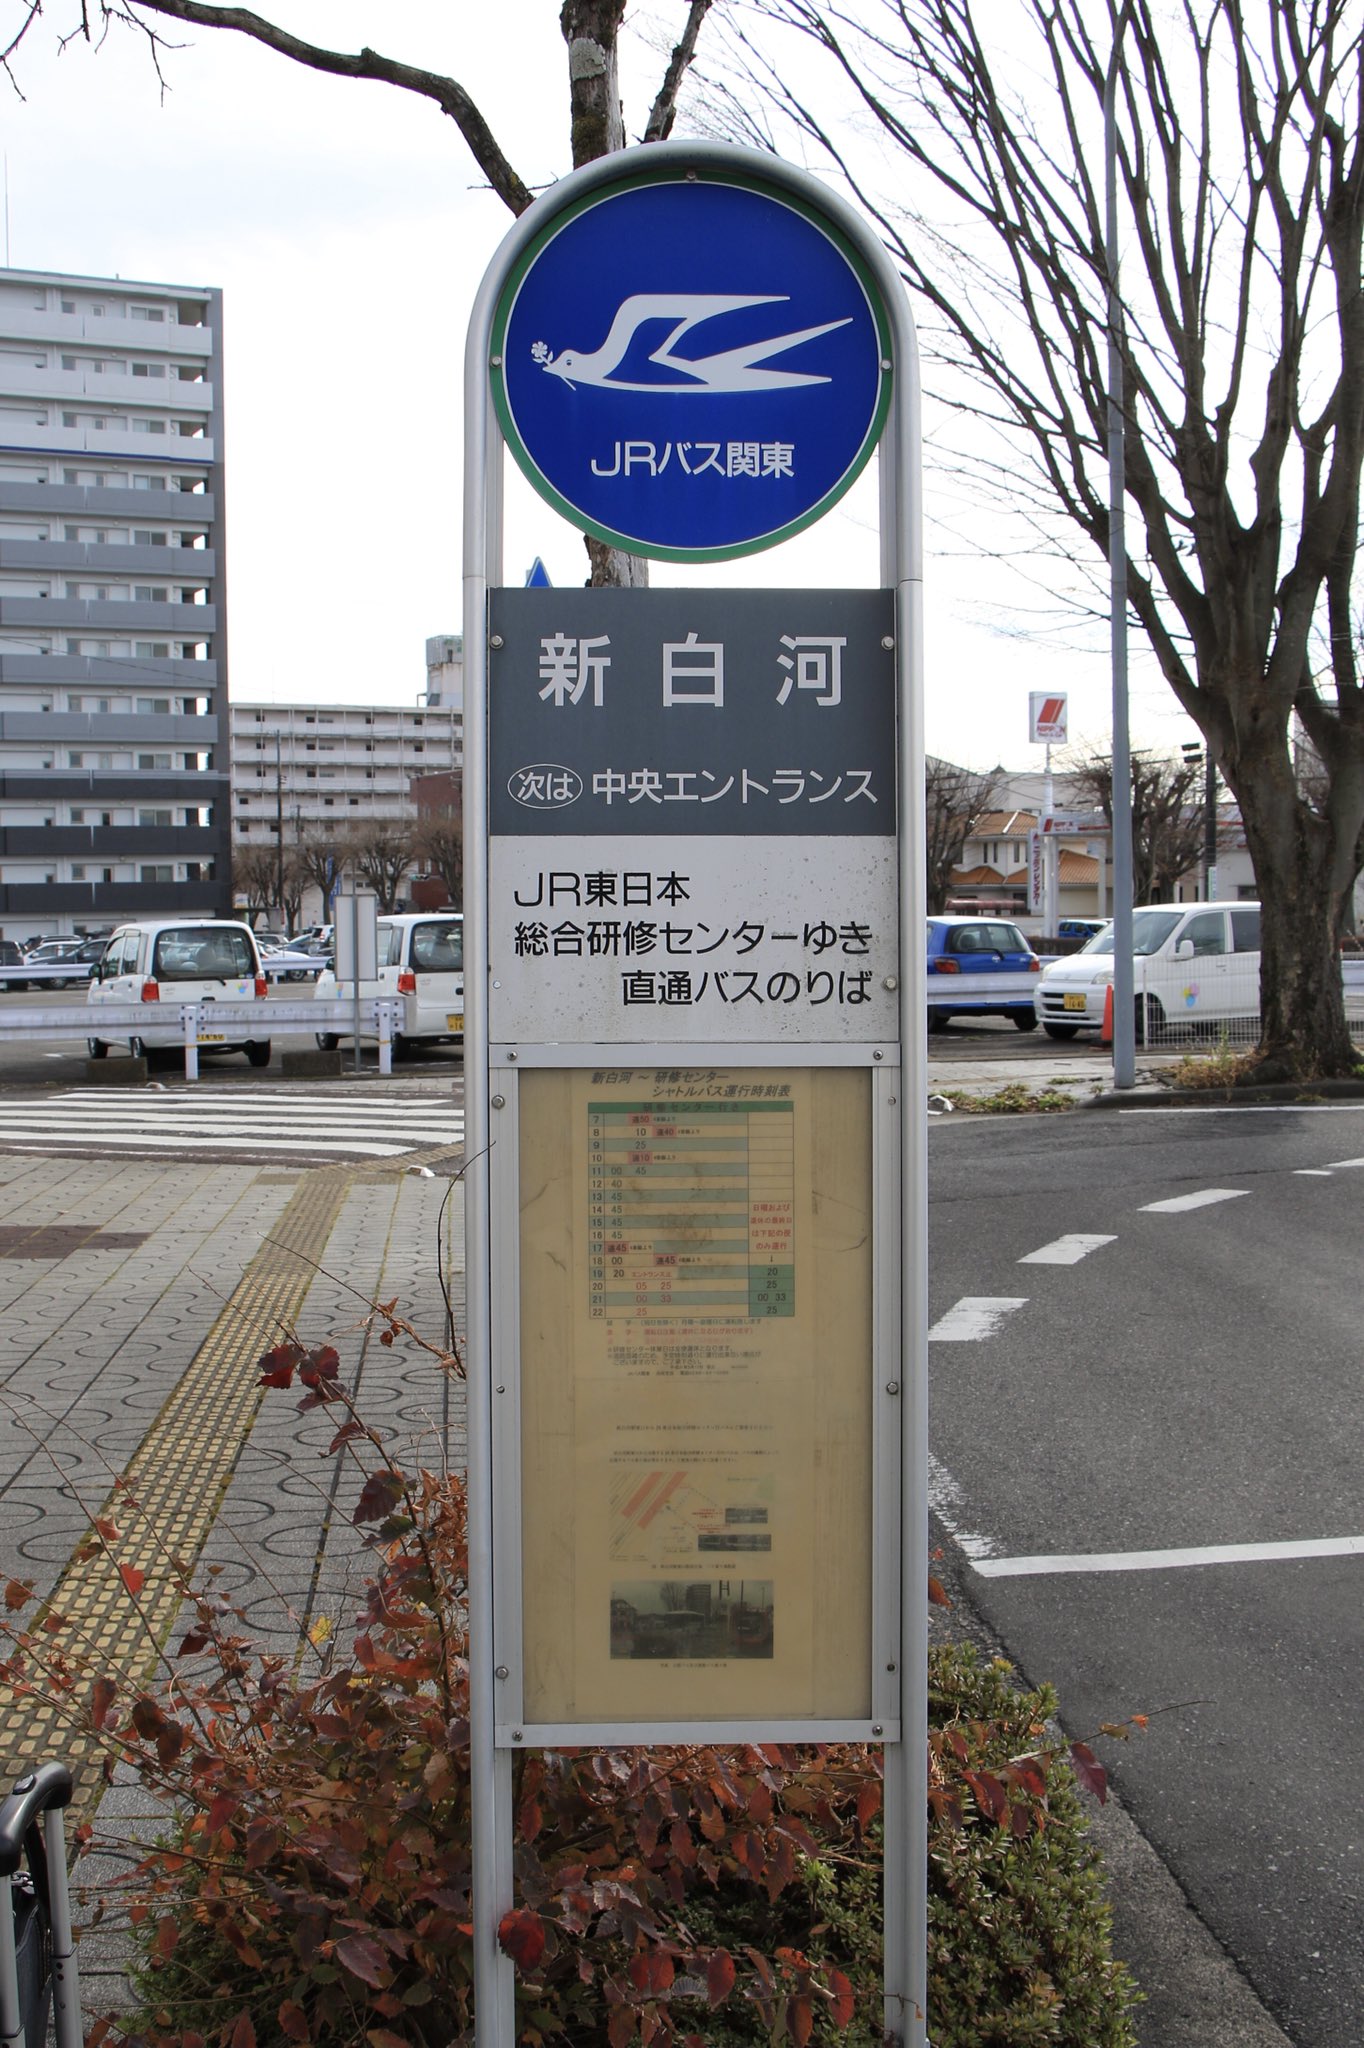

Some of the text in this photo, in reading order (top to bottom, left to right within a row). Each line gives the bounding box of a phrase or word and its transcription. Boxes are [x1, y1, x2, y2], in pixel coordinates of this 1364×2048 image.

[591, 441, 795, 478] JRバス関東
[538, 632, 847, 708] 新白河
[517, 768, 878, 805] 次は 中央エントランス
[514, 872, 691, 908] JR東日本
[514, 921, 872, 957] 総合研修センターゆき
[621, 969, 872, 1005] 直通バスのりば
[591, 1072, 633, 1085] 新白河
[654, 1071, 729, 1084] 研修センター
[652, 1084, 791, 1098] シャトルバス運行時刻表
[593, 1116, 599, 1124] 7
[593, 1129, 600, 1137] 8
[636, 1128, 647, 1137] 10
[593, 1141, 647, 1150] 9 25
[592, 1154, 602, 1162] 10
[592, 1167, 647, 1175] 11 00 45
[592, 1180, 623, 1188] 12 40
[592, 1193, 623, 1201] 13 45
[592, 1205, 623, 1214] 14 45
[592, 1218, 623, 1227] 15 45
[592, 1231, 623, 1240] 16 45
[592, 1244, 603, 1252] 17
[592, 1257, 603, 1265] 18
[611, 1257, 623, 1265] 00
[592, 1270, 603, 1278] 19
[613, 1269, 625, 1278] 20
[767, 1268, 779, 1276] 20
[592, 1280, 778, 1291] 20 05 25 25
[592, 1293, 786, 1303] 21 00 33 00 33
[592, 1306, 778, 1316] 22 25 25
